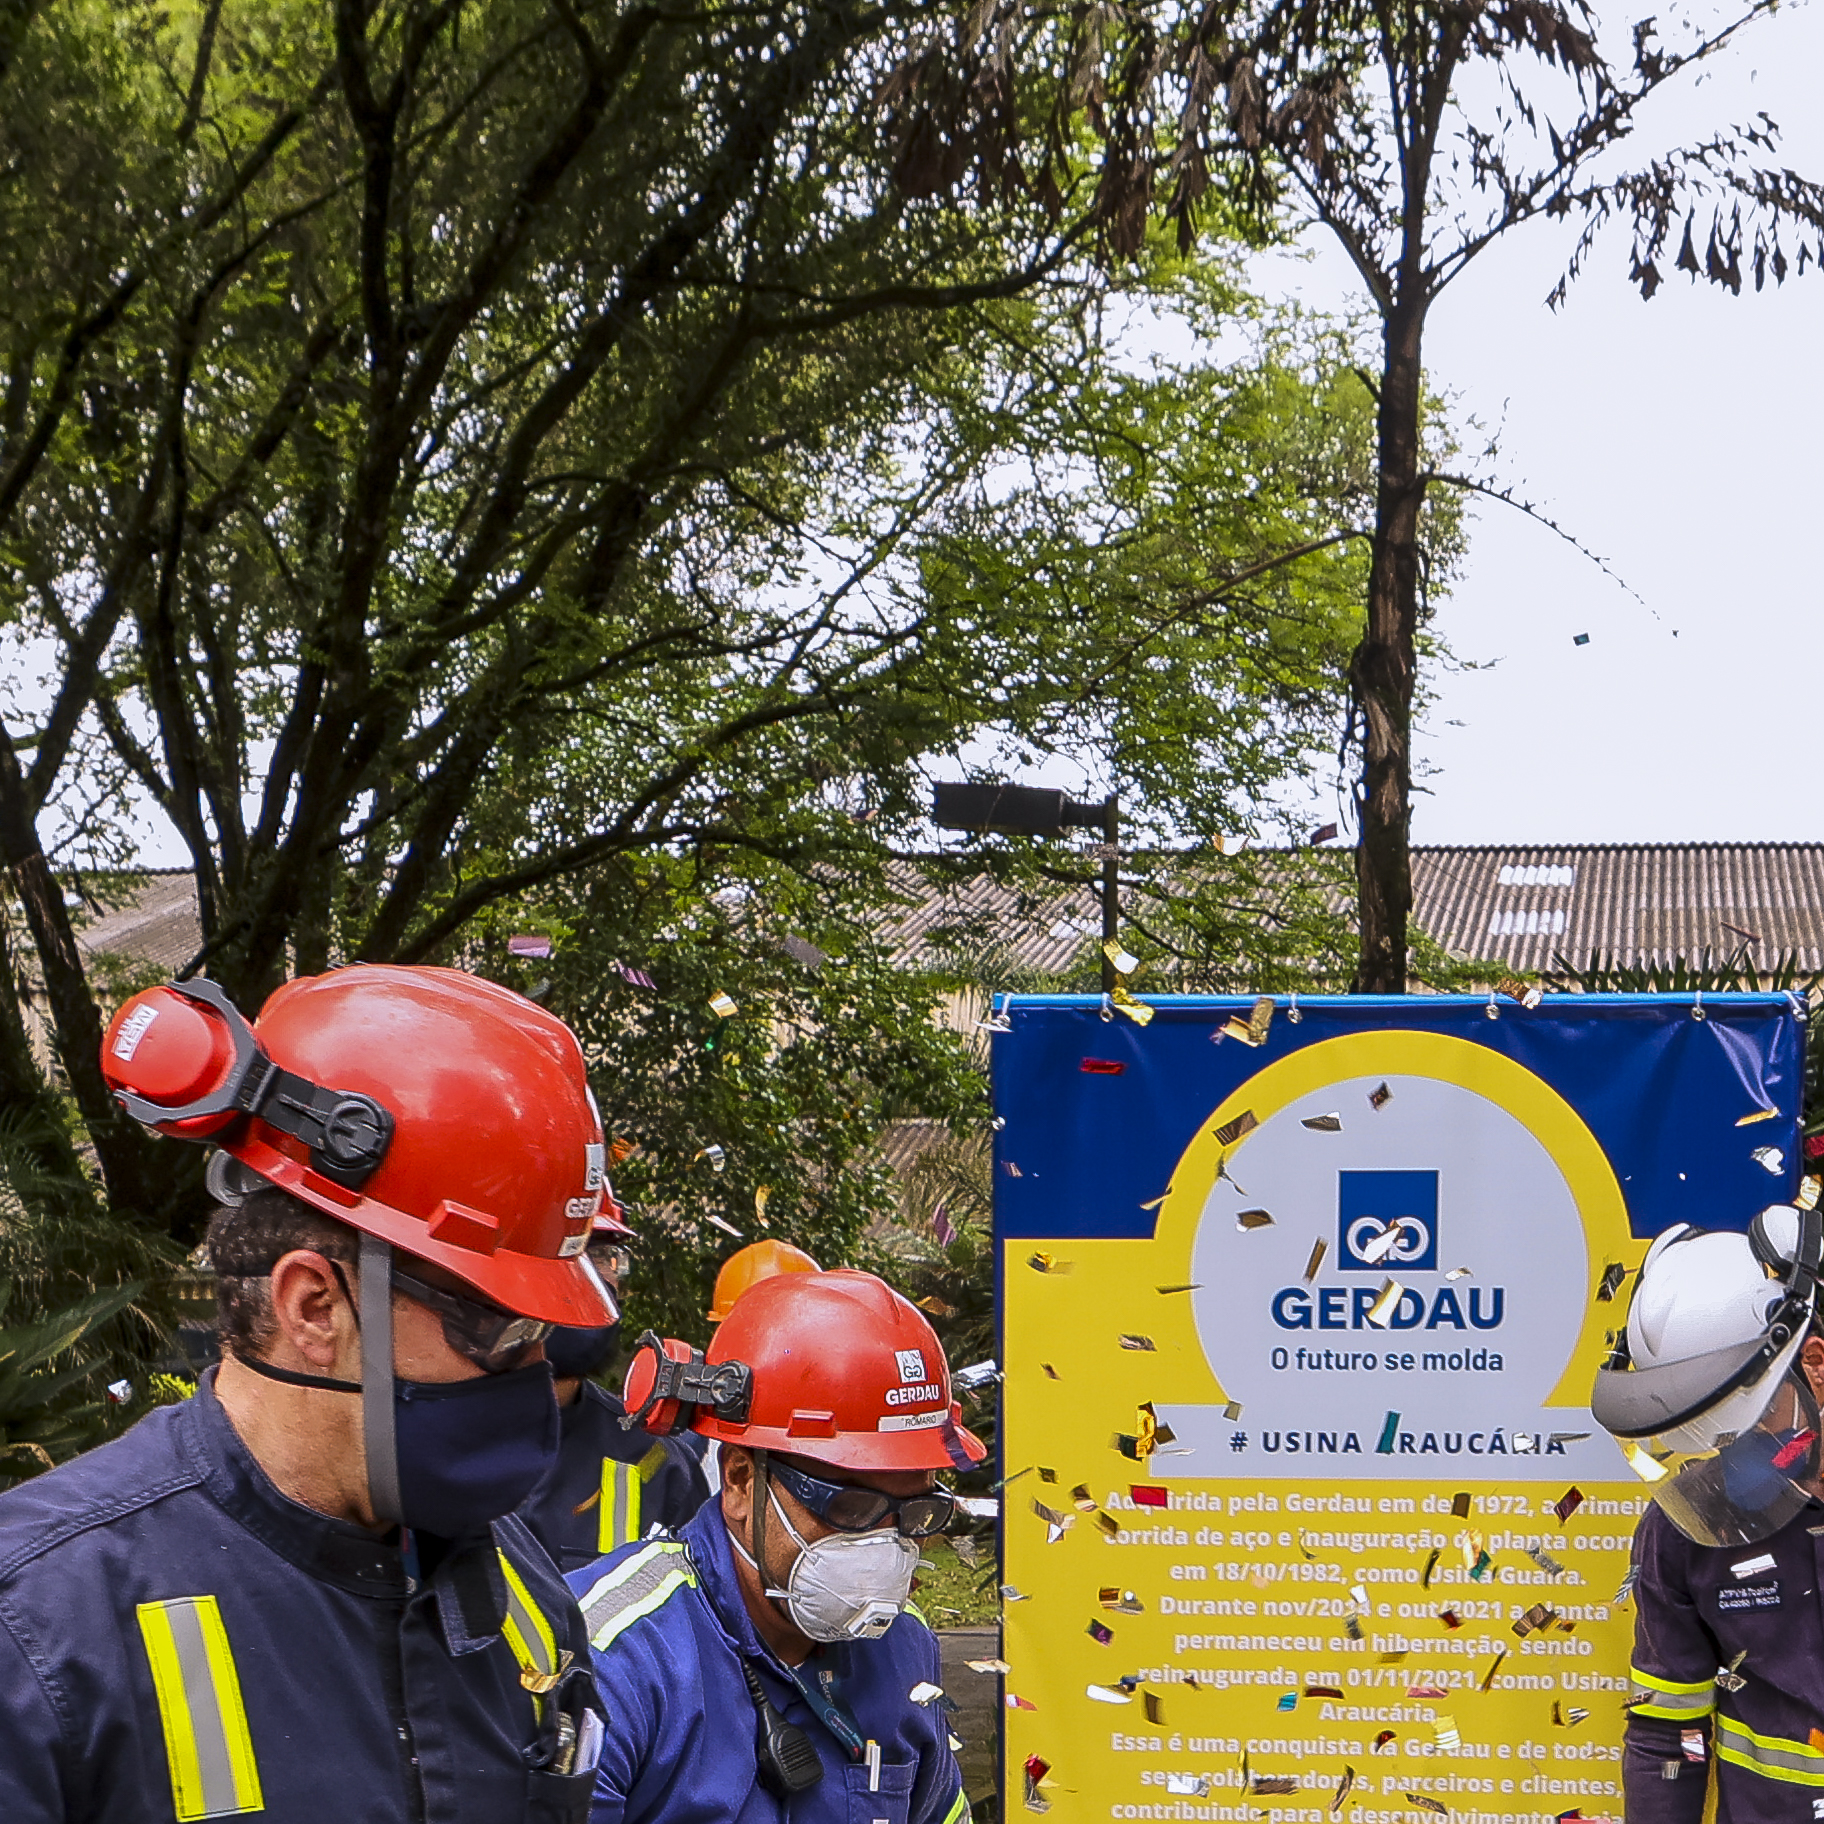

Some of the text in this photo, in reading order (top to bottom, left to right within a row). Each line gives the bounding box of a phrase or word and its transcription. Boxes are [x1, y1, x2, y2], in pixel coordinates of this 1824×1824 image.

[1271, 1287, 1504, 1330] GERDAU
[1271, 1348, 1503, 1371] O futuro se molda
[886, 1385, 939, 1405] GERDAU
[1230, 1428, 1567, 1455] # USINA RAUCÁIA
[1229, 1491, 1278, 1516] pela
[1286, 1493, 1371, 1513] Gerdau
[1378, 1498, 1415, 1514] em
[1422, 1494, 1469, 1515] de
[1475, 1496, 1535, 1518] 1972,
[1195, 1526, 1224, 1546] de
[1230, 1531, 1272, 1551] aço
[1278, 1532, 1292, 1546] e
[1453, 1530, 1481, 1549] d
[1489, 1530, 1567, 1553] planta
[1574, 1536, 1635, 1550] ocorr
[1170, 1564, 1207, 1580] em
[1214, 1562, 1348, 1584] 18/10/1982,
[1354, 1568, 1418, 1583] como
[1160, 1596, 1256, 1615] Durante
[1378, 1603, 1391, 1617] e
[1510, 1605, 1523, 1619] a
[1529, 1602, 1609, 1622] lanta
[1174, 1633, 1593, 1658] permaneceu em hibernação, sendo
[1138, 1664, 1629, 1691] reinaugurada em 01/11/2021, como Usina
[1318, 1702, 1437, 1723] Araucária
[1110, 1732, 1162, 1751] Essa
[1168, 1733, 1183, 1751] é
[1188, 1736, 1240, 1753] uma
[1246, 1736, 1363, 1759] conquista
[1370, 1739, 1397, 1757] da
[1497, 1743, 1512, 1759] e
[1517, 1740, 1547, 1760] de
[1382, 1773, 1493, 1795] parceiros
[1499, 1777, 1514, 1792] e
[1521, 1775, 1623, 1797] clientes,
[1329, 1808, 1343, 1823] o
